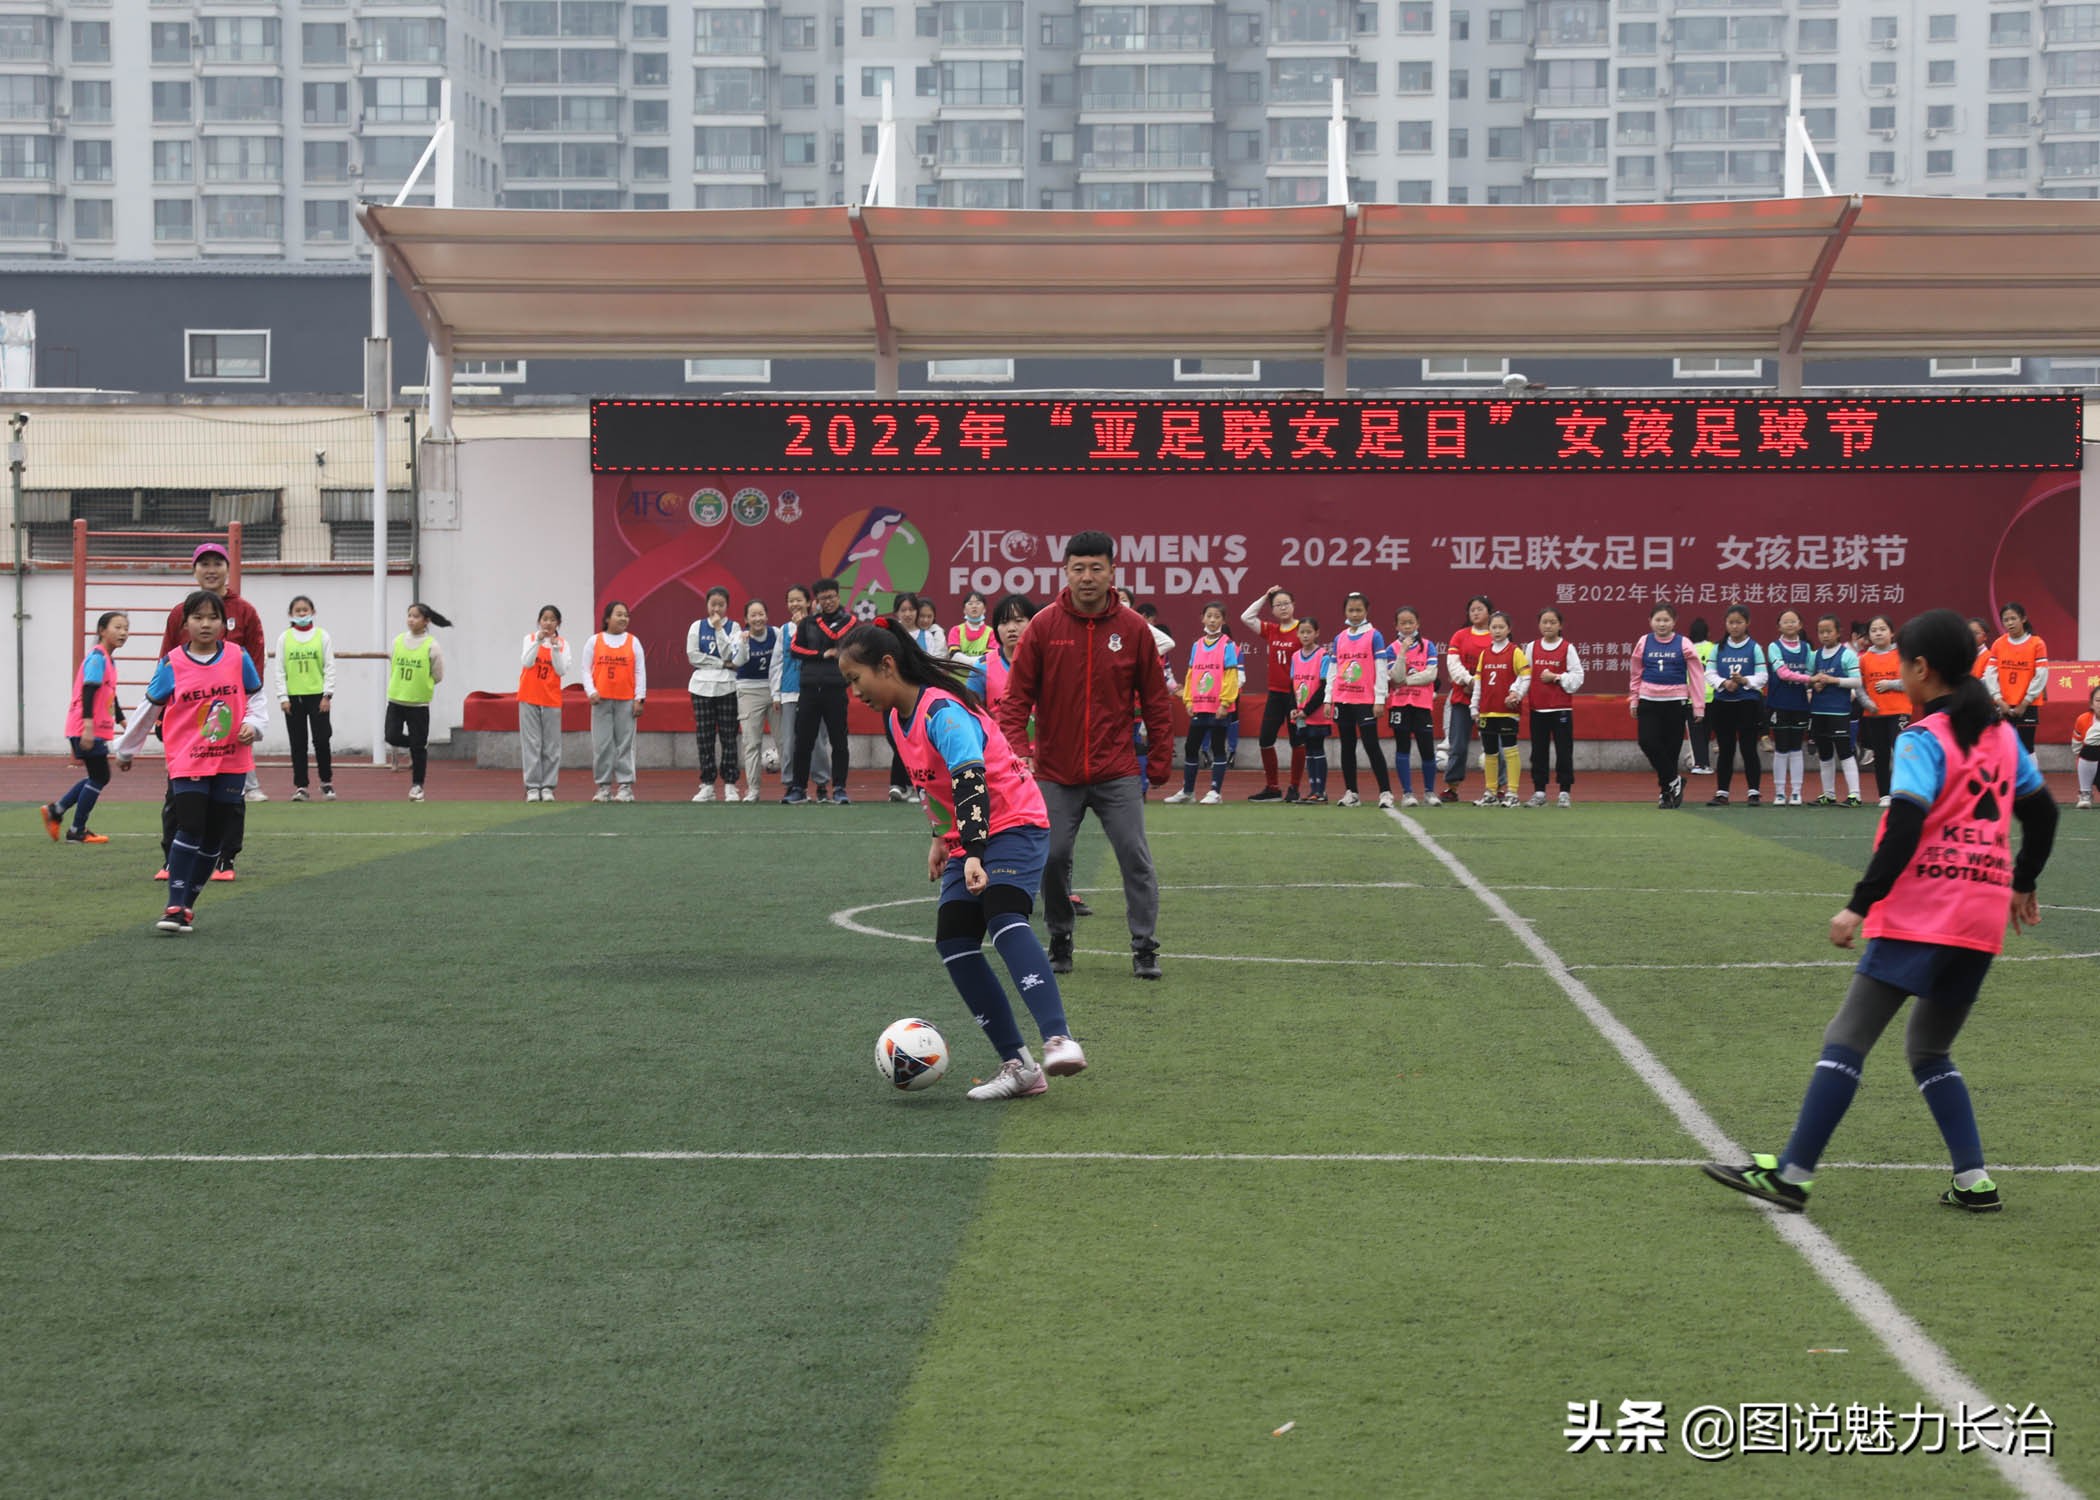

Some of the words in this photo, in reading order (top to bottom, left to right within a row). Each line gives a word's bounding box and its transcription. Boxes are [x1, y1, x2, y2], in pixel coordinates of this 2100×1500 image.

[951, 530, 1038, 562] AFC
[1046, 533, 1248, 562] WMEN'S
[950, 567, 1159, 595] FOOTLL
[1165, 567, 1249, 594] DAY
[1556, 583, 1905, 604] 暨2022年长治足球进校园系列活动
[709, 641, 717, 655] 9
[759, 657, 768, 671] 2
[1276, 650, 1288, 665] 11
[1657, 659, 1664, 672] 1
[400, 667, 413, 681] 10
[537, 666, 549, 680] 13
[1488, 671, 1497, 685] 2
[181, 685, 232, 703] KELME
